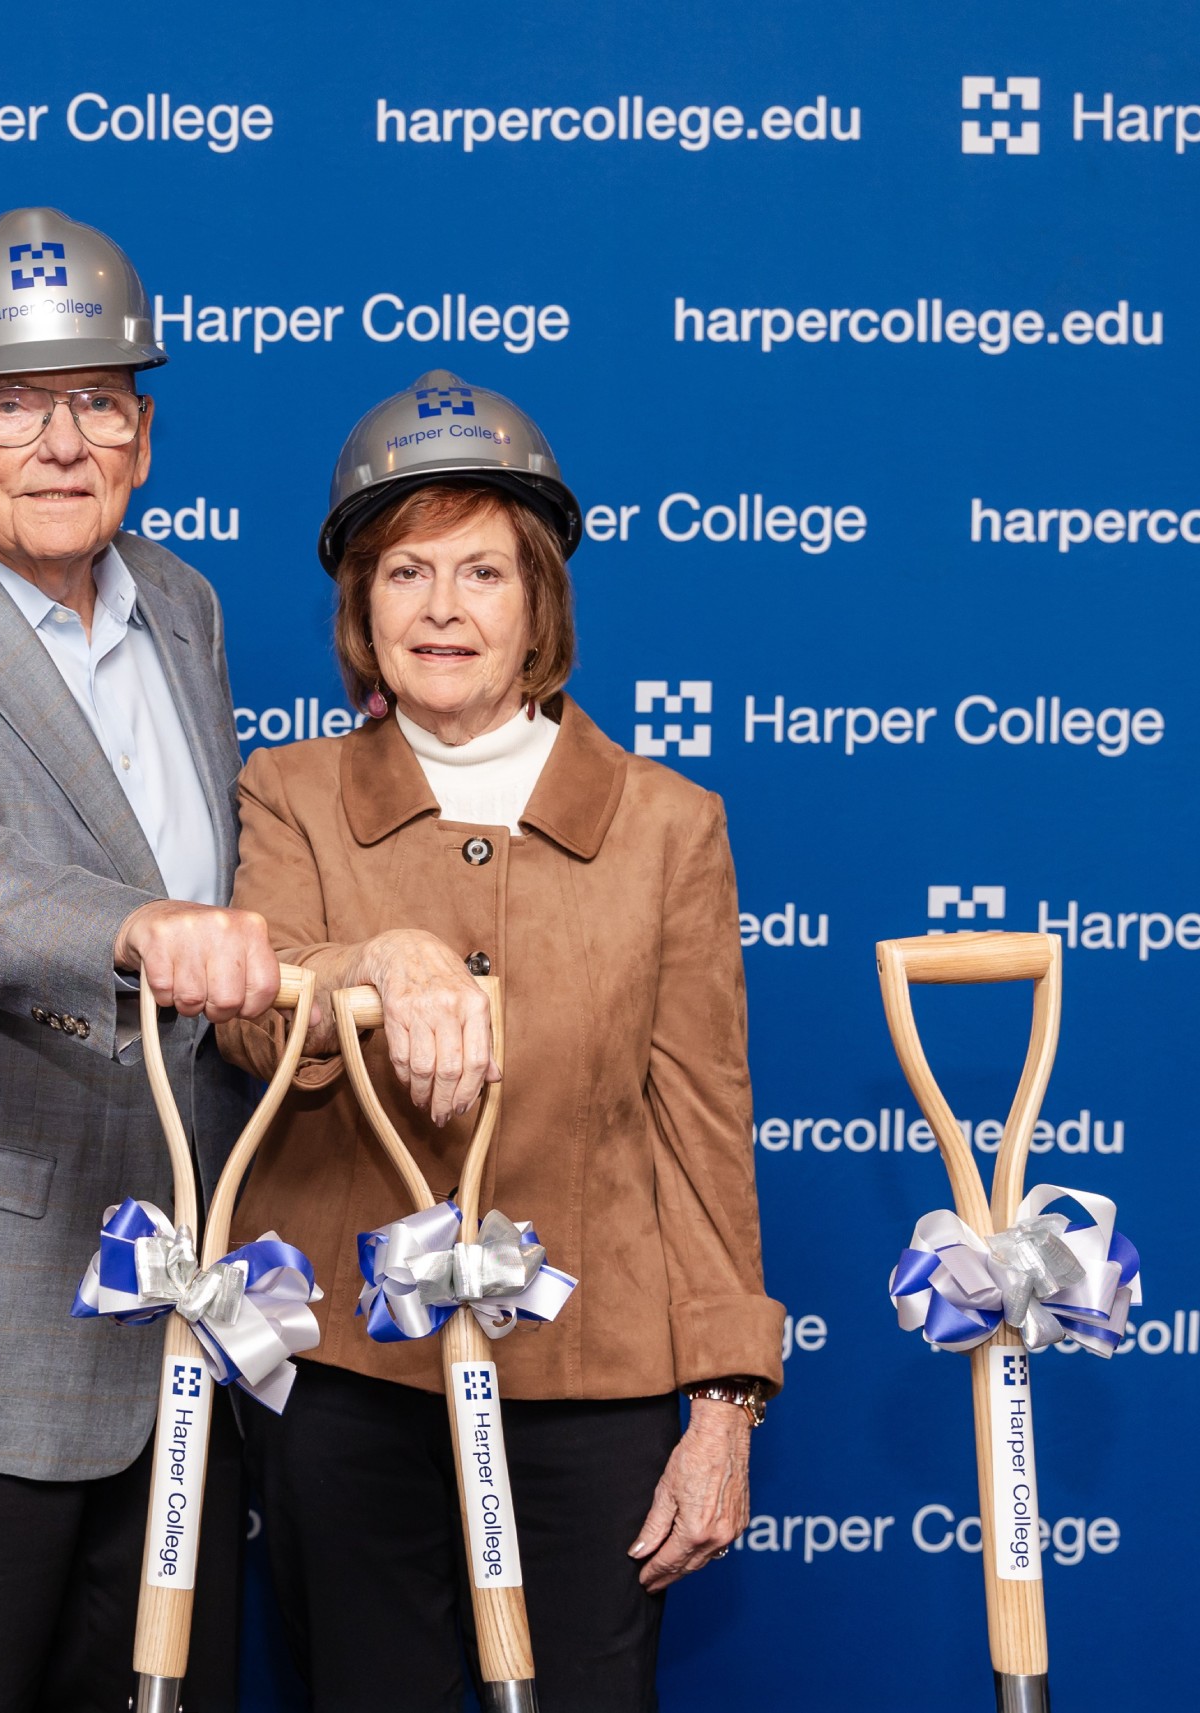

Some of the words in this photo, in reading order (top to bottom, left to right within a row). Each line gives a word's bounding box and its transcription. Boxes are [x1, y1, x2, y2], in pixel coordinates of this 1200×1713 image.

[66, 92, 275, 155] College
[376, 95, 861, 153] harpercollege.edu
[42, 299, 103, 318] College
[154, 293, 345, 354] Harper
[362, 292, 570, 354] College
[674, 297, 1163, 355] harpercollege.edu
[386, 427, 444, 451] Harper
[448, 424, 511, 445] College
[657, 492, 868, 556] College
[234, 697, 370, 740] colle
[744, 695, 938, 757] Harper
[954, 693, 1165, 757] College
[168, 1408, 194, 1486] Harper
[472, 1412, 494, 1487] Harper
[1006, 1399, 1027, 1476] Harper
[734, 1515, 896, 1563] arper
